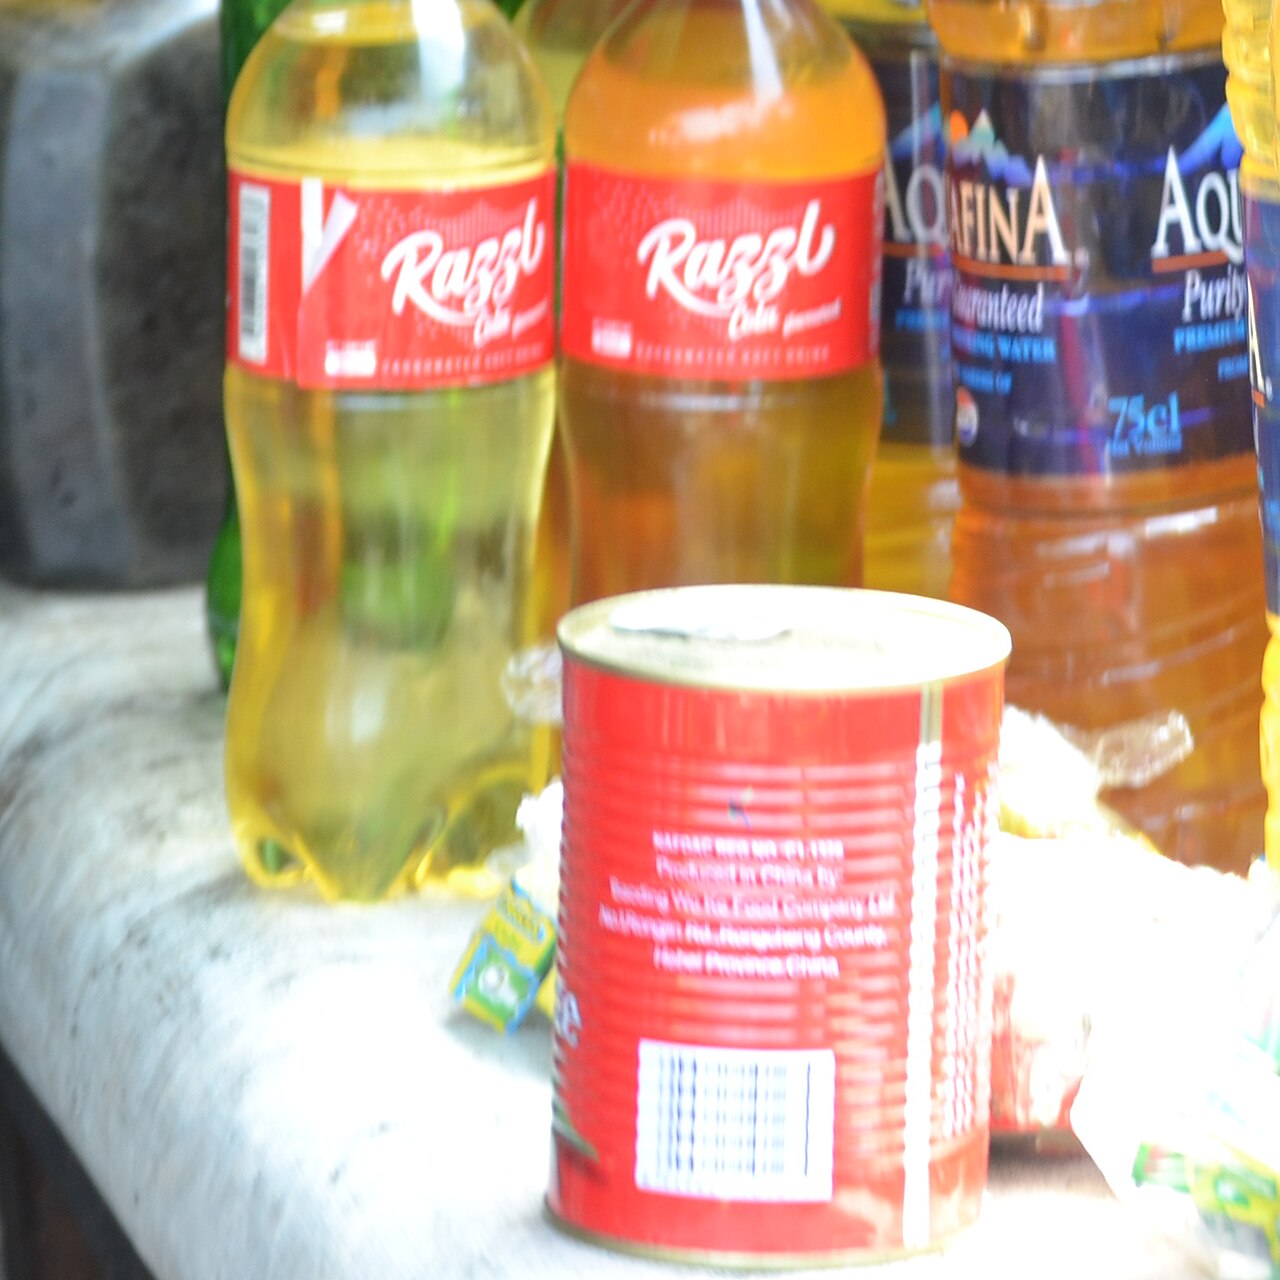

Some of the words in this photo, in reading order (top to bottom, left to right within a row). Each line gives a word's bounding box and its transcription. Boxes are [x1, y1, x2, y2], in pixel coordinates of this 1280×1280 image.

[380, 197, 545, 327] Razzl
[636, 198, 836, 319] Razzl
[1107, 391, 1181, 442] 75cl
